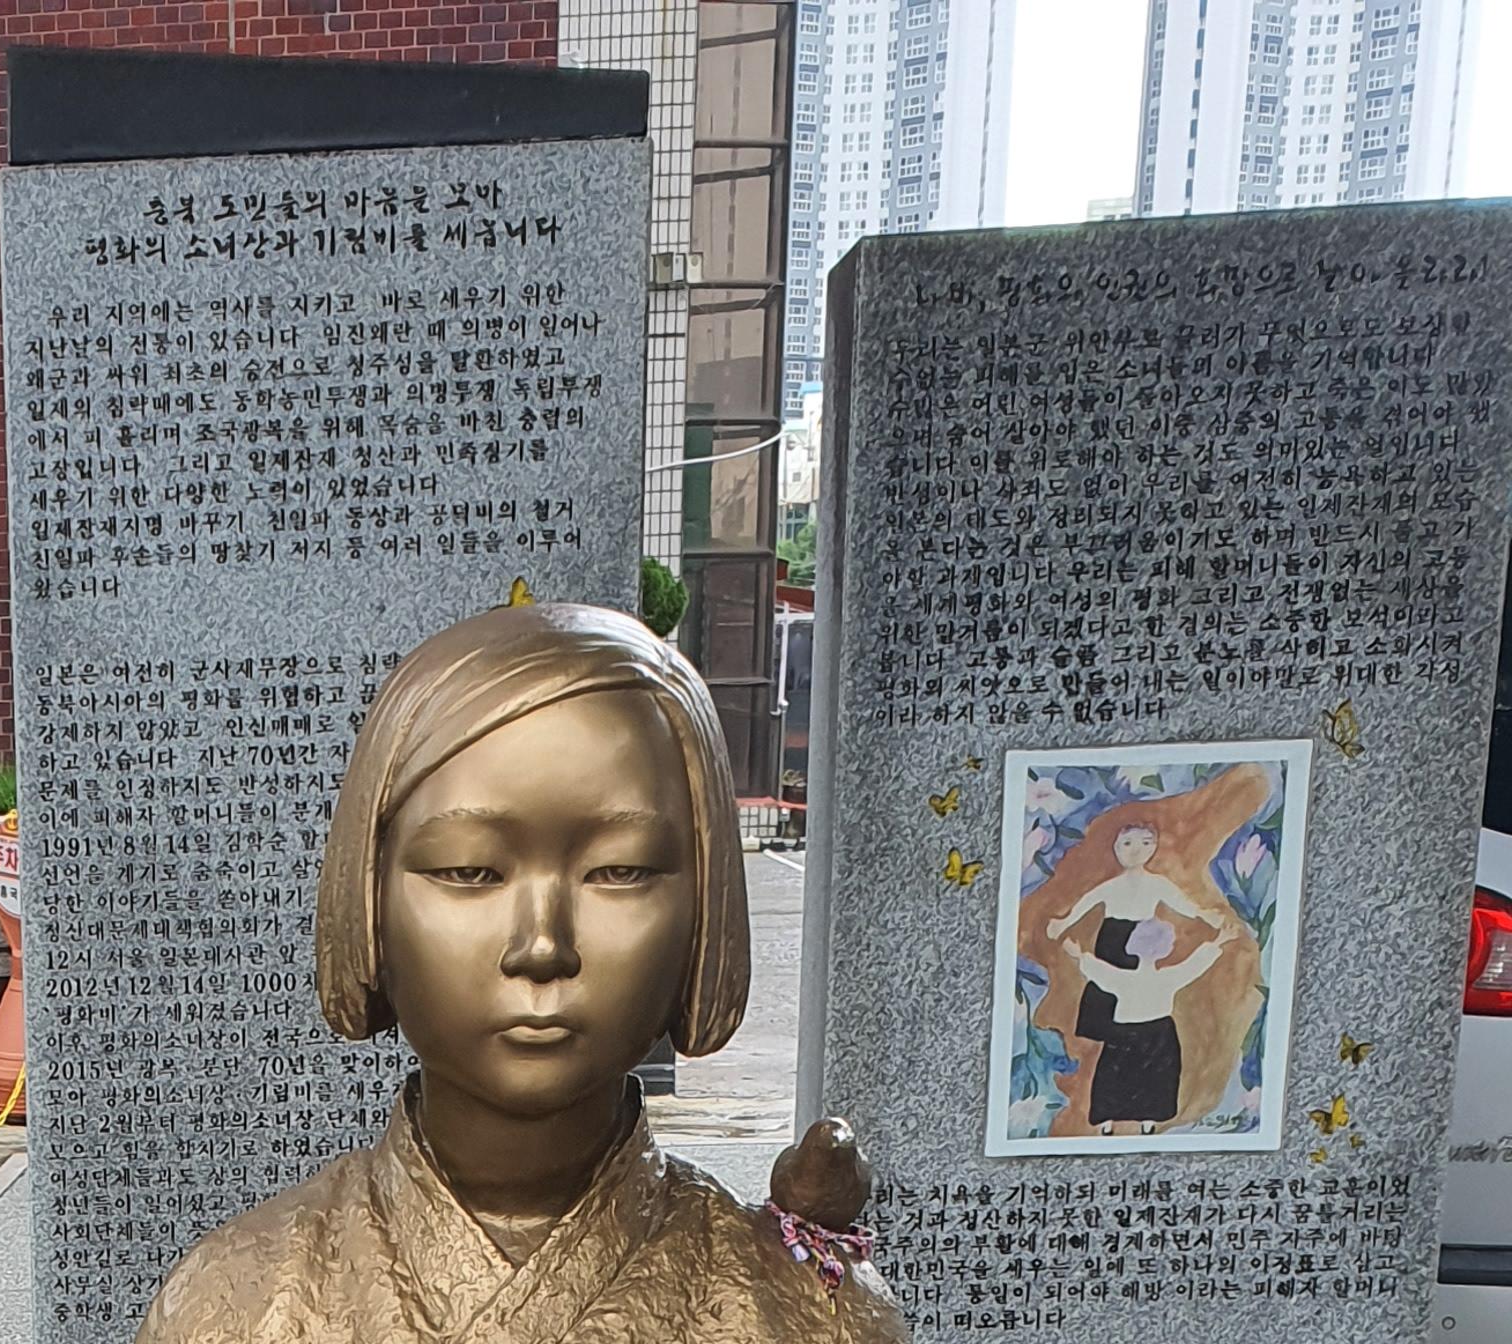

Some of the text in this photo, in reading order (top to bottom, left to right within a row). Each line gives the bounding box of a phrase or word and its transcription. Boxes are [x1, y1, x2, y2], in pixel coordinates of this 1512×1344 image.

[143, 194, 194, 225] 충북
[214, 190, 326, 221] 도민들의
[85, 214, 562, 265] 평화의 소녀상과 기림비를 세웁니다
[47, 303, 89, 329] 우리
[105, 300, 193, 326] 지역에는
[210, 296, 276, 323] 역사를
[290, 292, 355, 318] 지키고
[440, 285, 506, 310] 세우기
[209, 325, 299, 352] 있습니다
[241, 356, 332, 381] 승전으로
[27, 427, 68, 451] 에서
[29, 454, 141, 481] 고장입니다
[169, 451, 234, 474] 그리고
[30, 487, 93, 511] 세우기
[328, 472, 439, 499] 있었습니다
[36, 663, 99, 686] 일본은
[112, 660, 175, 684] 여전히
[38, 690, 165, 716] 동북아시아의
[260, 684, 345, 708] 위협하고
[38, 721, 124, 745] 강제하지
[226, 713, 337, 738] 인신매매로
[40, 752, 80, 773] 하고
[94, 748, 177, 771] 있습니다
[198, 745, 239, 768] 지난
[116, 776, 226, 799] 인정하지도
[39, 801, 278, 829] 이에 피해자 할머니들이
[41, 836, 113, 858] 1991년
[166, 832, 212, 854] 14일
